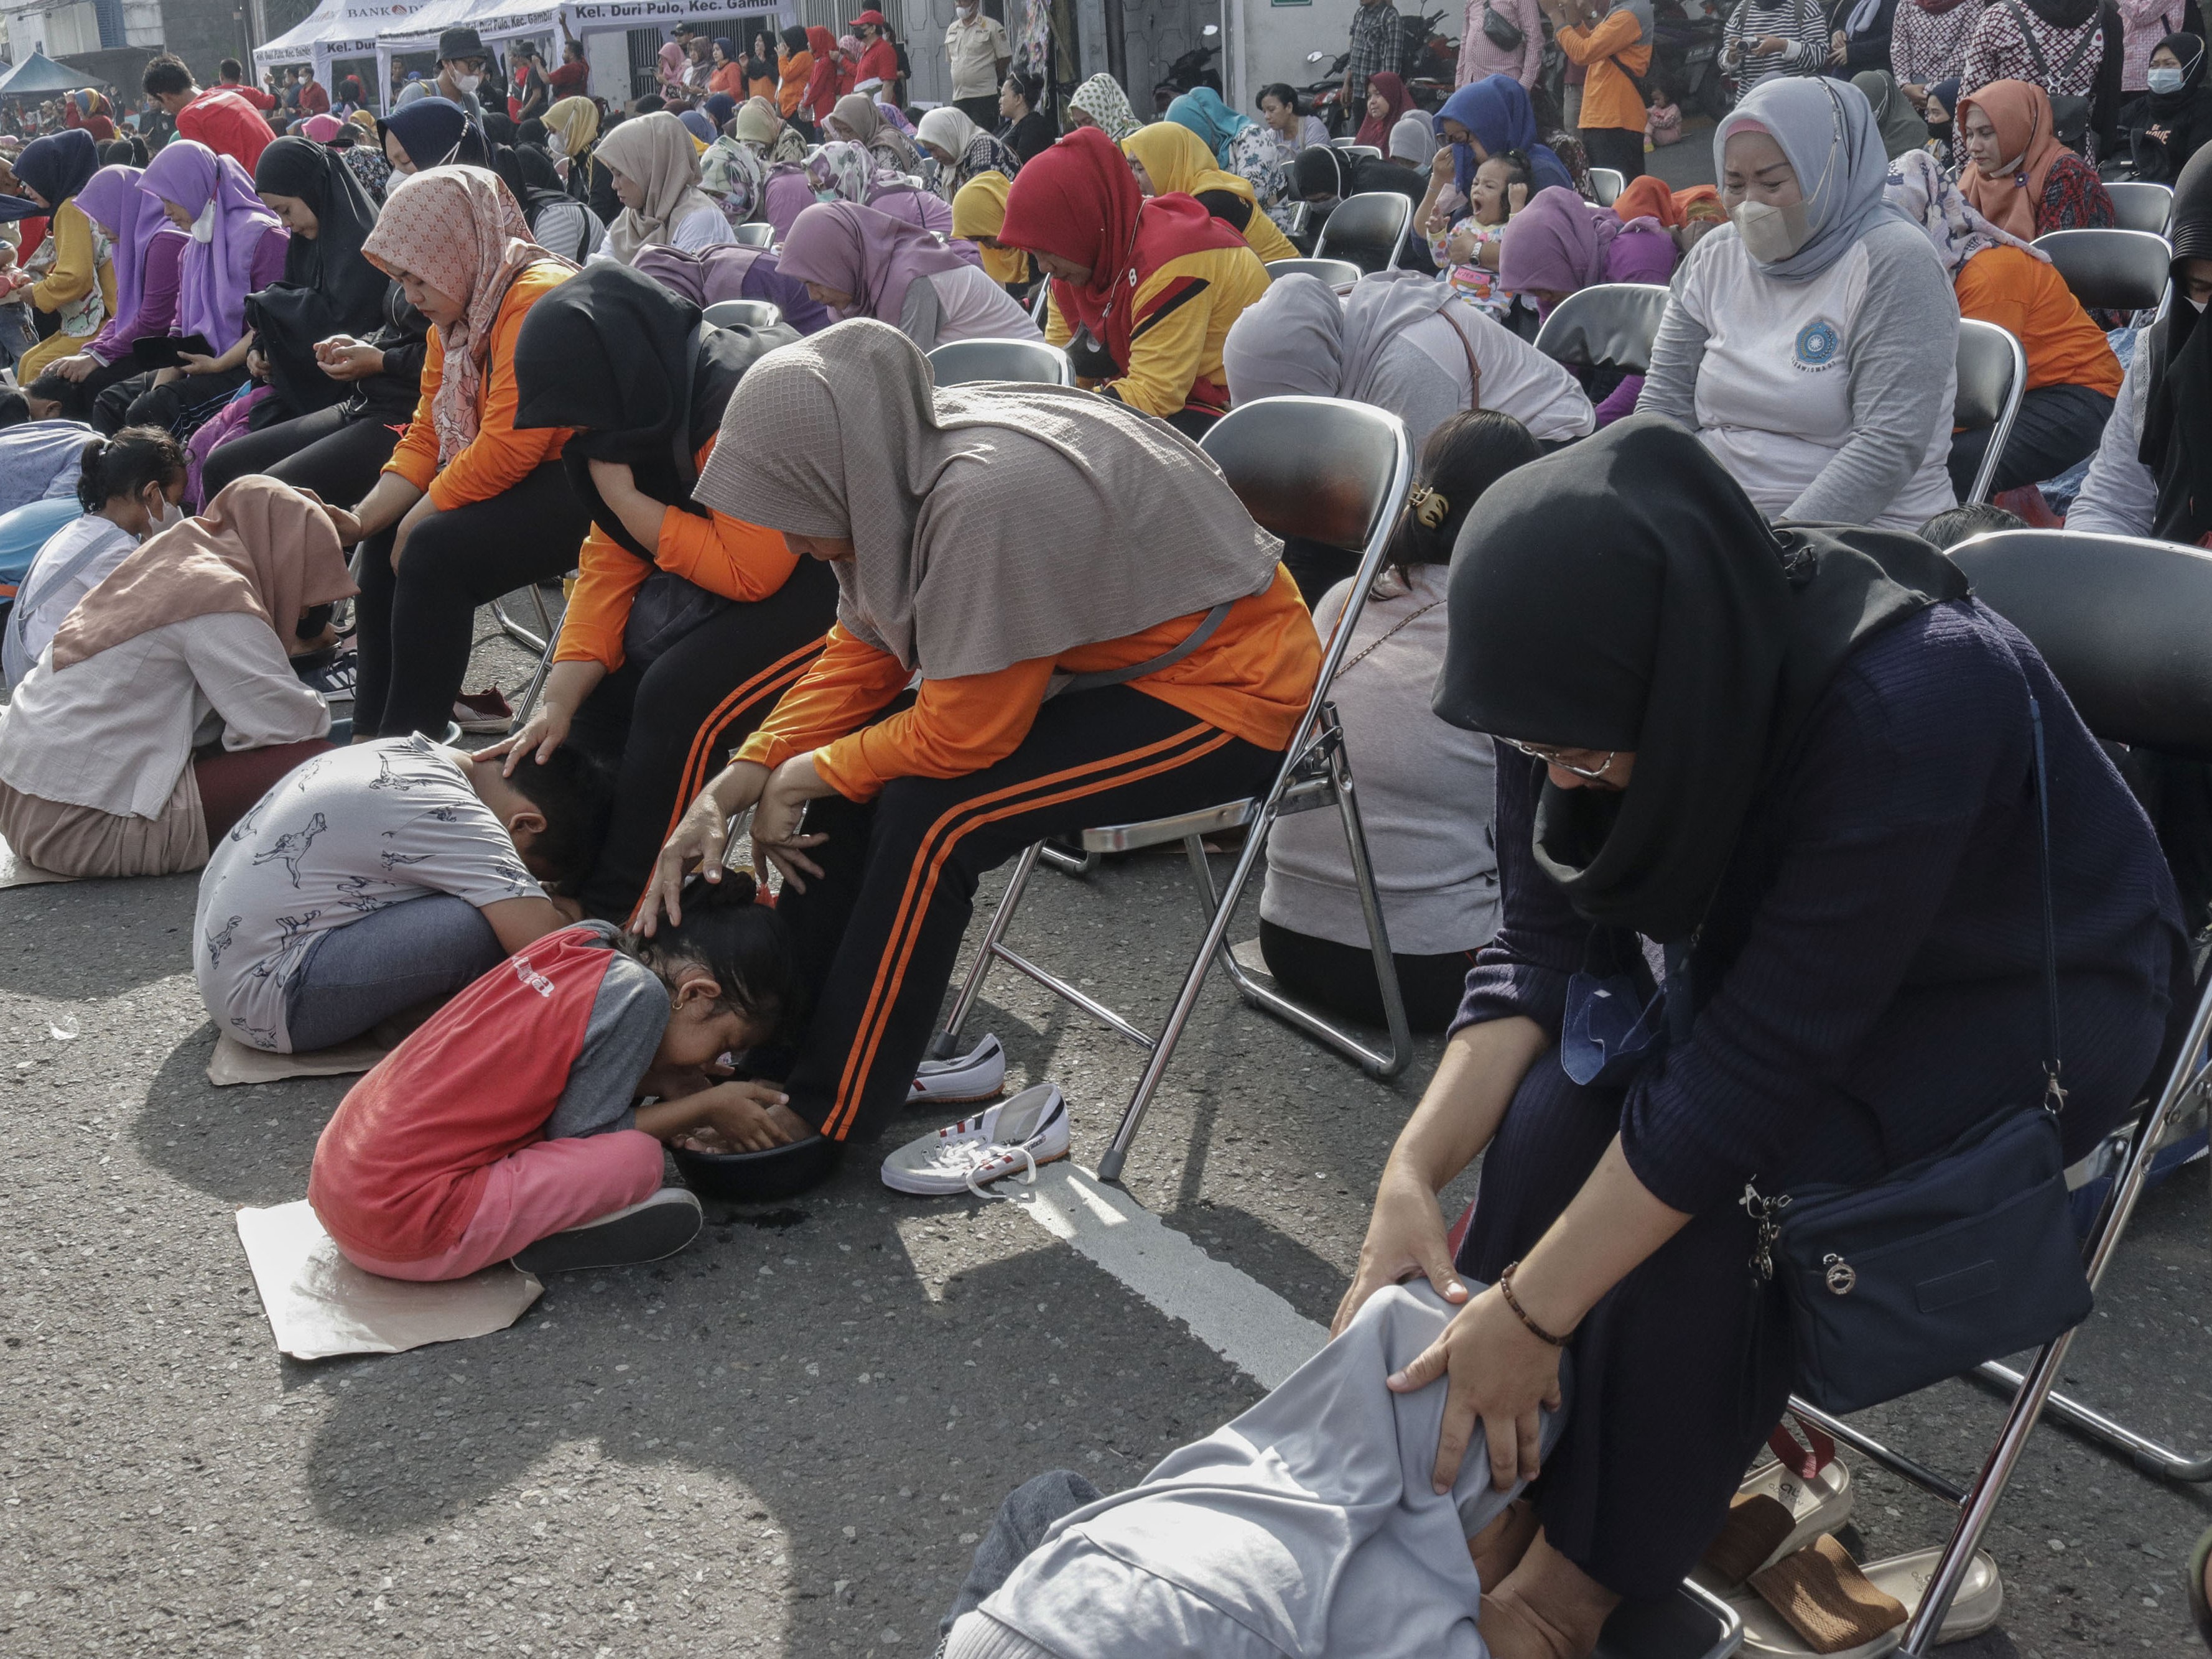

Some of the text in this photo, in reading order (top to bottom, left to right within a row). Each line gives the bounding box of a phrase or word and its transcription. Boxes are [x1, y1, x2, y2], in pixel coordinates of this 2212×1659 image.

[348, 7, 391, 17] BANK
[575, 6, 606, 19] Kel.
[611, 4, 641, 17] Duri
[647, 2, 684, 14] Pulo,
[689, 1, 722, 12] Kec.
[479, 21, 493, 33] Duri
[494, 18, 510, 30] Pulo,
[511, 16, 527, 28] Kec.
[527, 11, 552, 24] Gambir
[327, 43, 351, 53] Kel.
